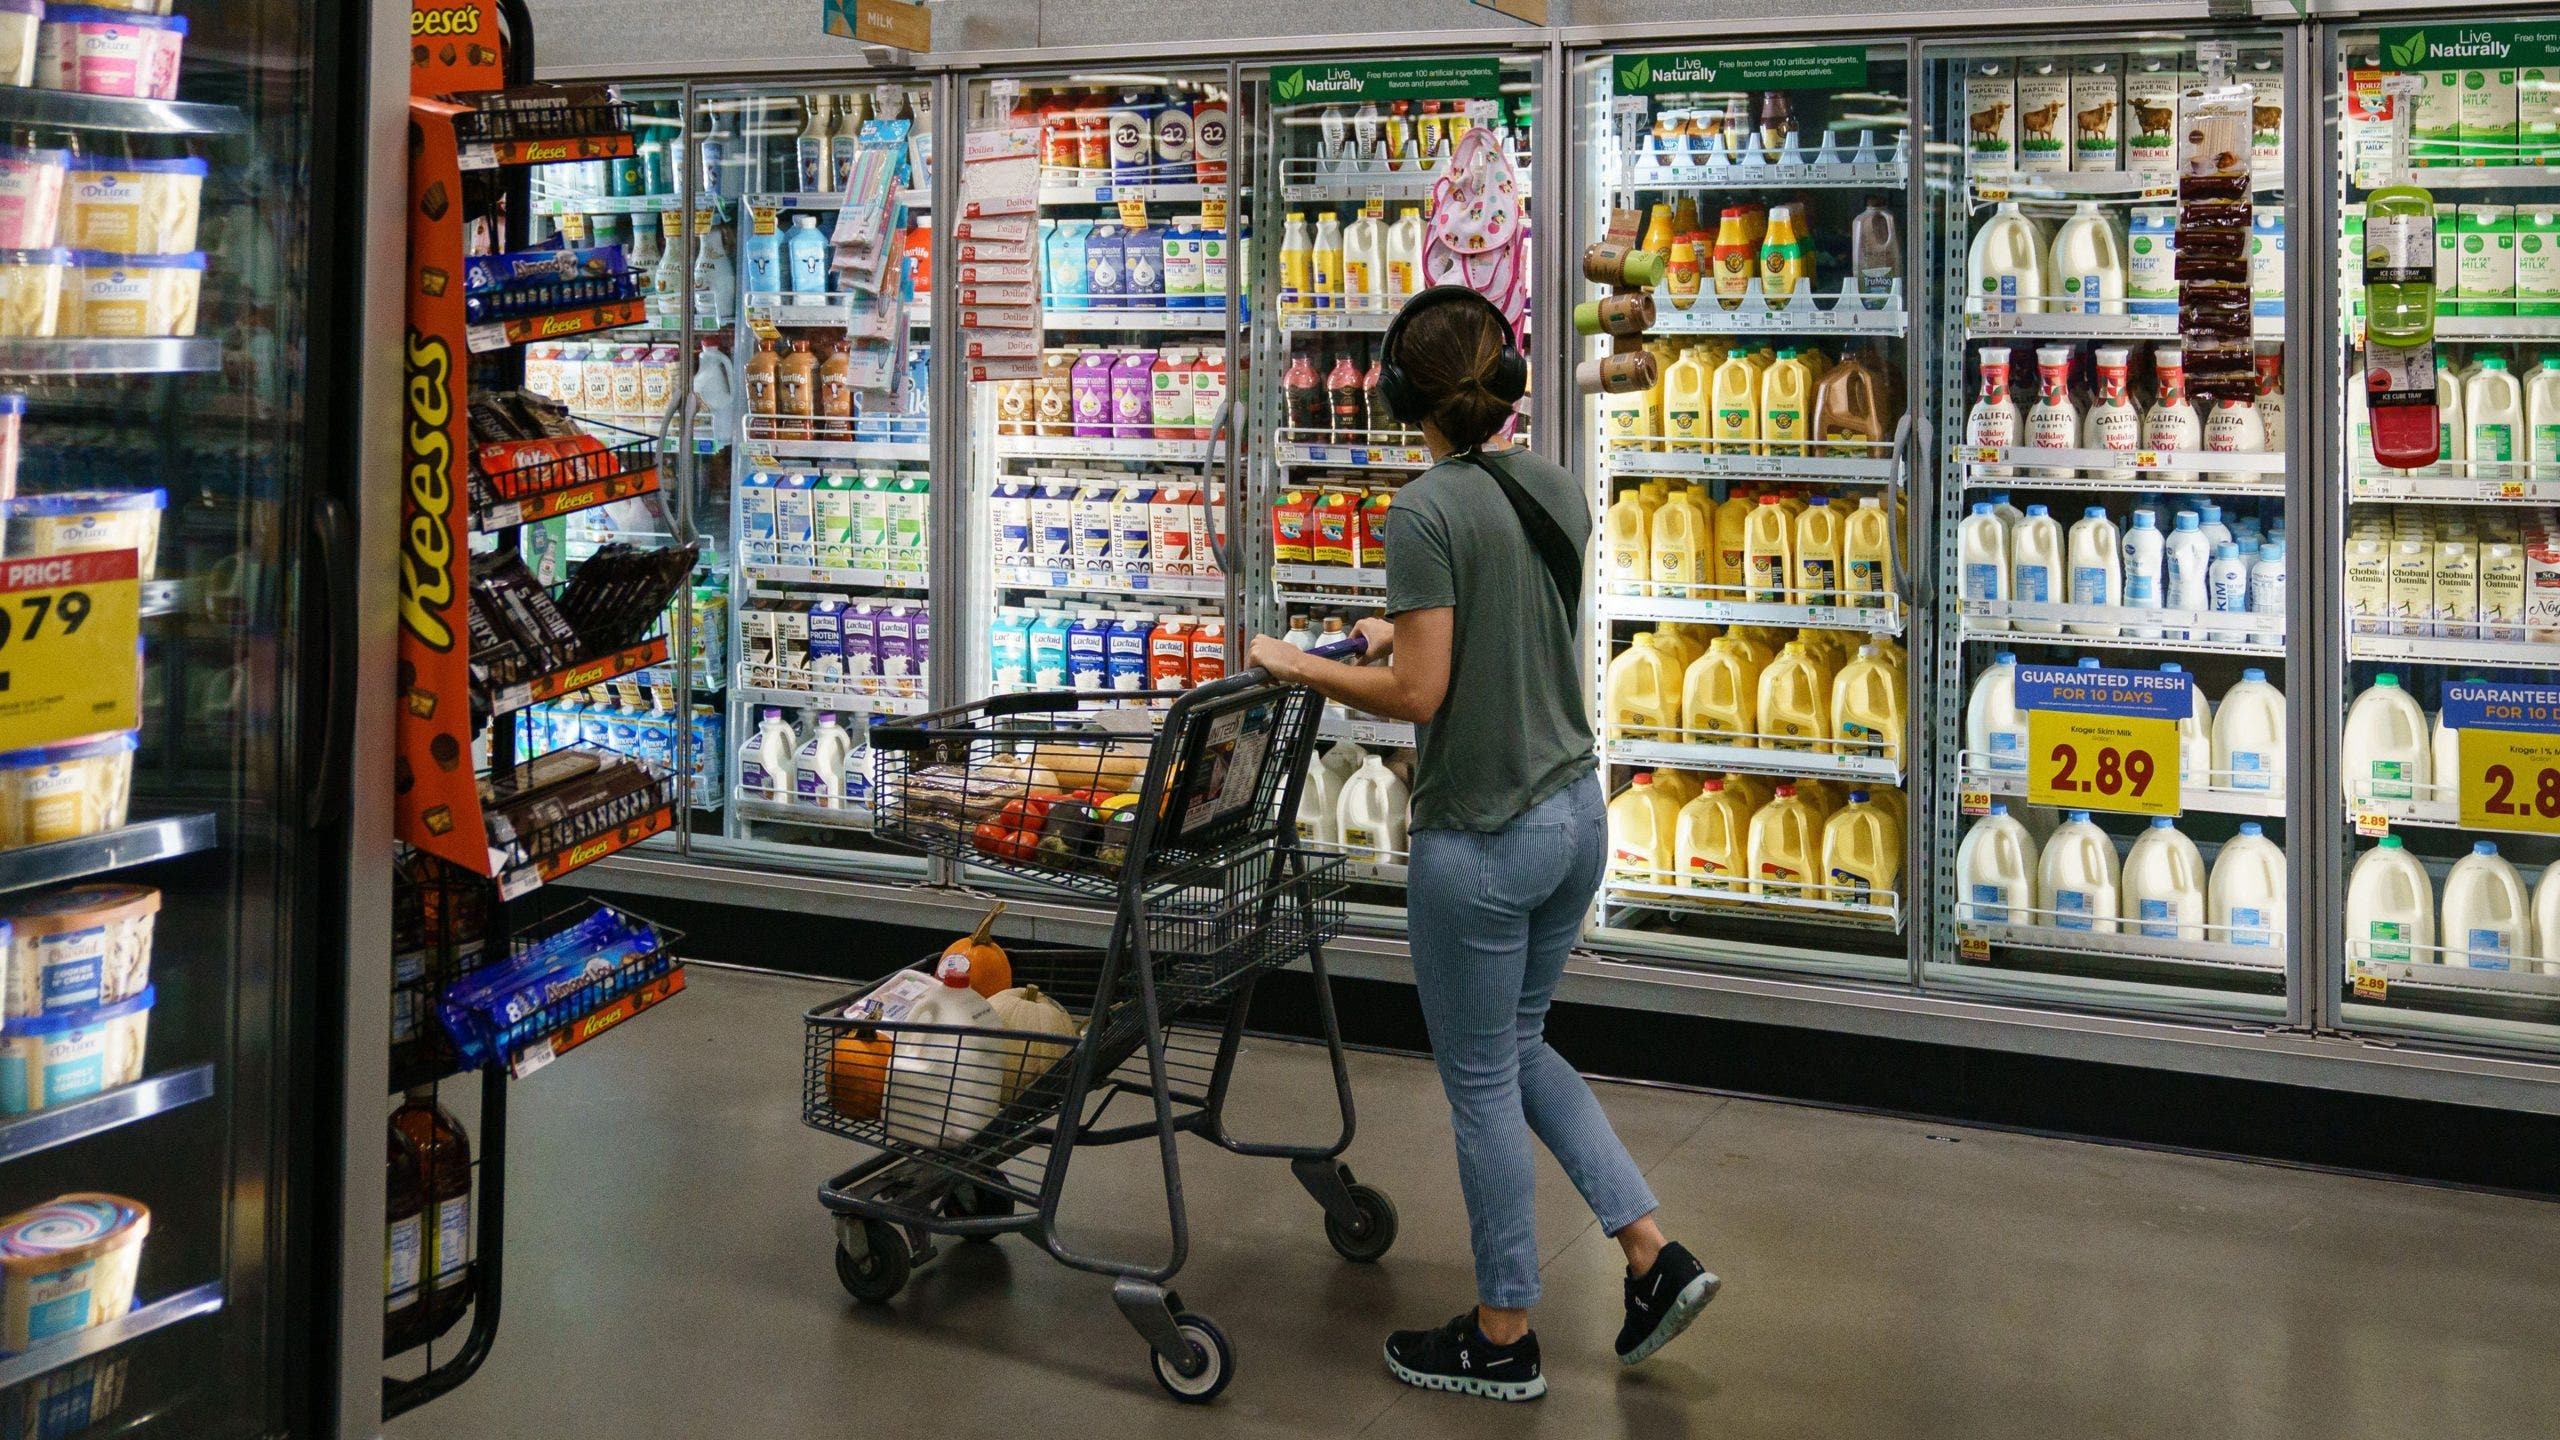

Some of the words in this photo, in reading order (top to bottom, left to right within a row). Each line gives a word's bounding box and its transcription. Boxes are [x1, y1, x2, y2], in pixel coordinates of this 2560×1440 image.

[411, 6, 481, 35] eese's
[867, 11, 894, 29] MILK
[2460, 29, 2491, 44] Live
[2514, 33, 2535, 42] Free
[2536, 33, 2557, 41] from
[2430, 41, 2511, 58] Naturally
[1676, 57, 1702, 70] Live
[1719, 61, 1735, 69] Free
[1736, 60, 1753, 68] from
[1773, 58, 1786, 66] 100
[1788, 57, 1815, 66] artificial
[1327, 68, 1351, 80] Live
[1366, 71, 1381, 79] Free
[1429, 69, 1454, 77] artificial
[1652, 67, 1716, 83] Naturally
[1743, 69, 1767, 78] flavors
[1768, 69, 1782, 77] and
[1306, 78, 1364, 92] Naturally
[1388, 80, 1410, 88] flavors
[2356, 82, 2382, 91] HORIZ
[2522, 95, 2548, 103] MILK
[1117, 129, 1138, 144] a2
[1163, 127, 1184, 142] a2
[1203, 126, 1224, 141] a2
[1427, 124, 1435, 157] Nesquik
[526, 141, 567, 160] Reese's
[2263, 149, 2279, 157] MILK
[1122, 204, 1141, 212] 3.99
[2131, 262, 2156, 270] MILK
[2461, 261, 2487, 269] MILK
[2519, 261, 2545, 269] MILK
[542, 315, 582, 335] Reese's
[591, 384, 605, 392] OAT
[619, 384, 633, 392] OAT
[649, 385, 662, 393] OAT
[1972, 412, 2013, 422] CALIFIA
[2030, 413, 2072, 423] CALIFIA
[1977, 430, 2005, 439] Holiday
[2035, 431, 2064, 442] Holiday
[1979, 437, 2004, 448] Nog
[2037, 439, 2063, 448] Nog
[401, 333, 450, 648] Reese's
[2504, 485, 2521, 493] 3.99
[1278, 510, 1304, 519] HORIZON
[1319, 511, 1346, 520] HORIZON
[8, 558, 73, 586] PRICE
[2349, 568, 2385, 576] Chobani
[2392, 569, 2430, 578] Chobani
[2436, 571, 2474, 580] Chobani
[2483, 573, 2521, 582] Chobani
[2351, 575, 2383, 583] Oatmilk
[2394, 576, 2428, 585] Oatmilk
[2438, 578, 2472, 587] Oatmilk
[2485, 580, 2519, 589] Oatmilk
[812, 616, 836, 627] Lactaid
[846, 621, 871, 632] Lactaid
[881, 624, 907, 633] Lactaid
[810, 631, 839, 640] PROTEIN
[1073, 636, 1100, 647] Lactaid
[1113, 638, 1140, 649] Lactaid
[1155, 641, 1183, 652] Lactaid
[1195, 643, 1222, 653] Lactaid
[2022, 671, 2129, 687] GUARANTEED
[2134, 676, 2185, 690] FRESH
[2053, 687, 2085, 700] FOR
[2091, 690, 2107, 701] 10
[2112, 691, 2154, 704] DAYS
[2450, 687, 2560, 704] GUARANTEE
[2485, 705, 2522, 719] FOR
[2528, 706, 2547, 720] 10
[2071, 726, 2096, 736] Kroger
[2097, 727, 2115, 736] Skim
[2117, 729, 2132, 737] Milk
[2510, 745, 2537, 756] Kroger
[2540, 746, 2553, 756] 1%
[2051, 743, 2155, 797] 2.89
[2484, 764, 2560, 818] 2.8
[1964, 793, 1989, 805] 2.89
[2359, 815, 2386, 827] 2.89
[1963, 938, 1987, 950] 2.89
[2357, 976, 2385, 989] 2.89
